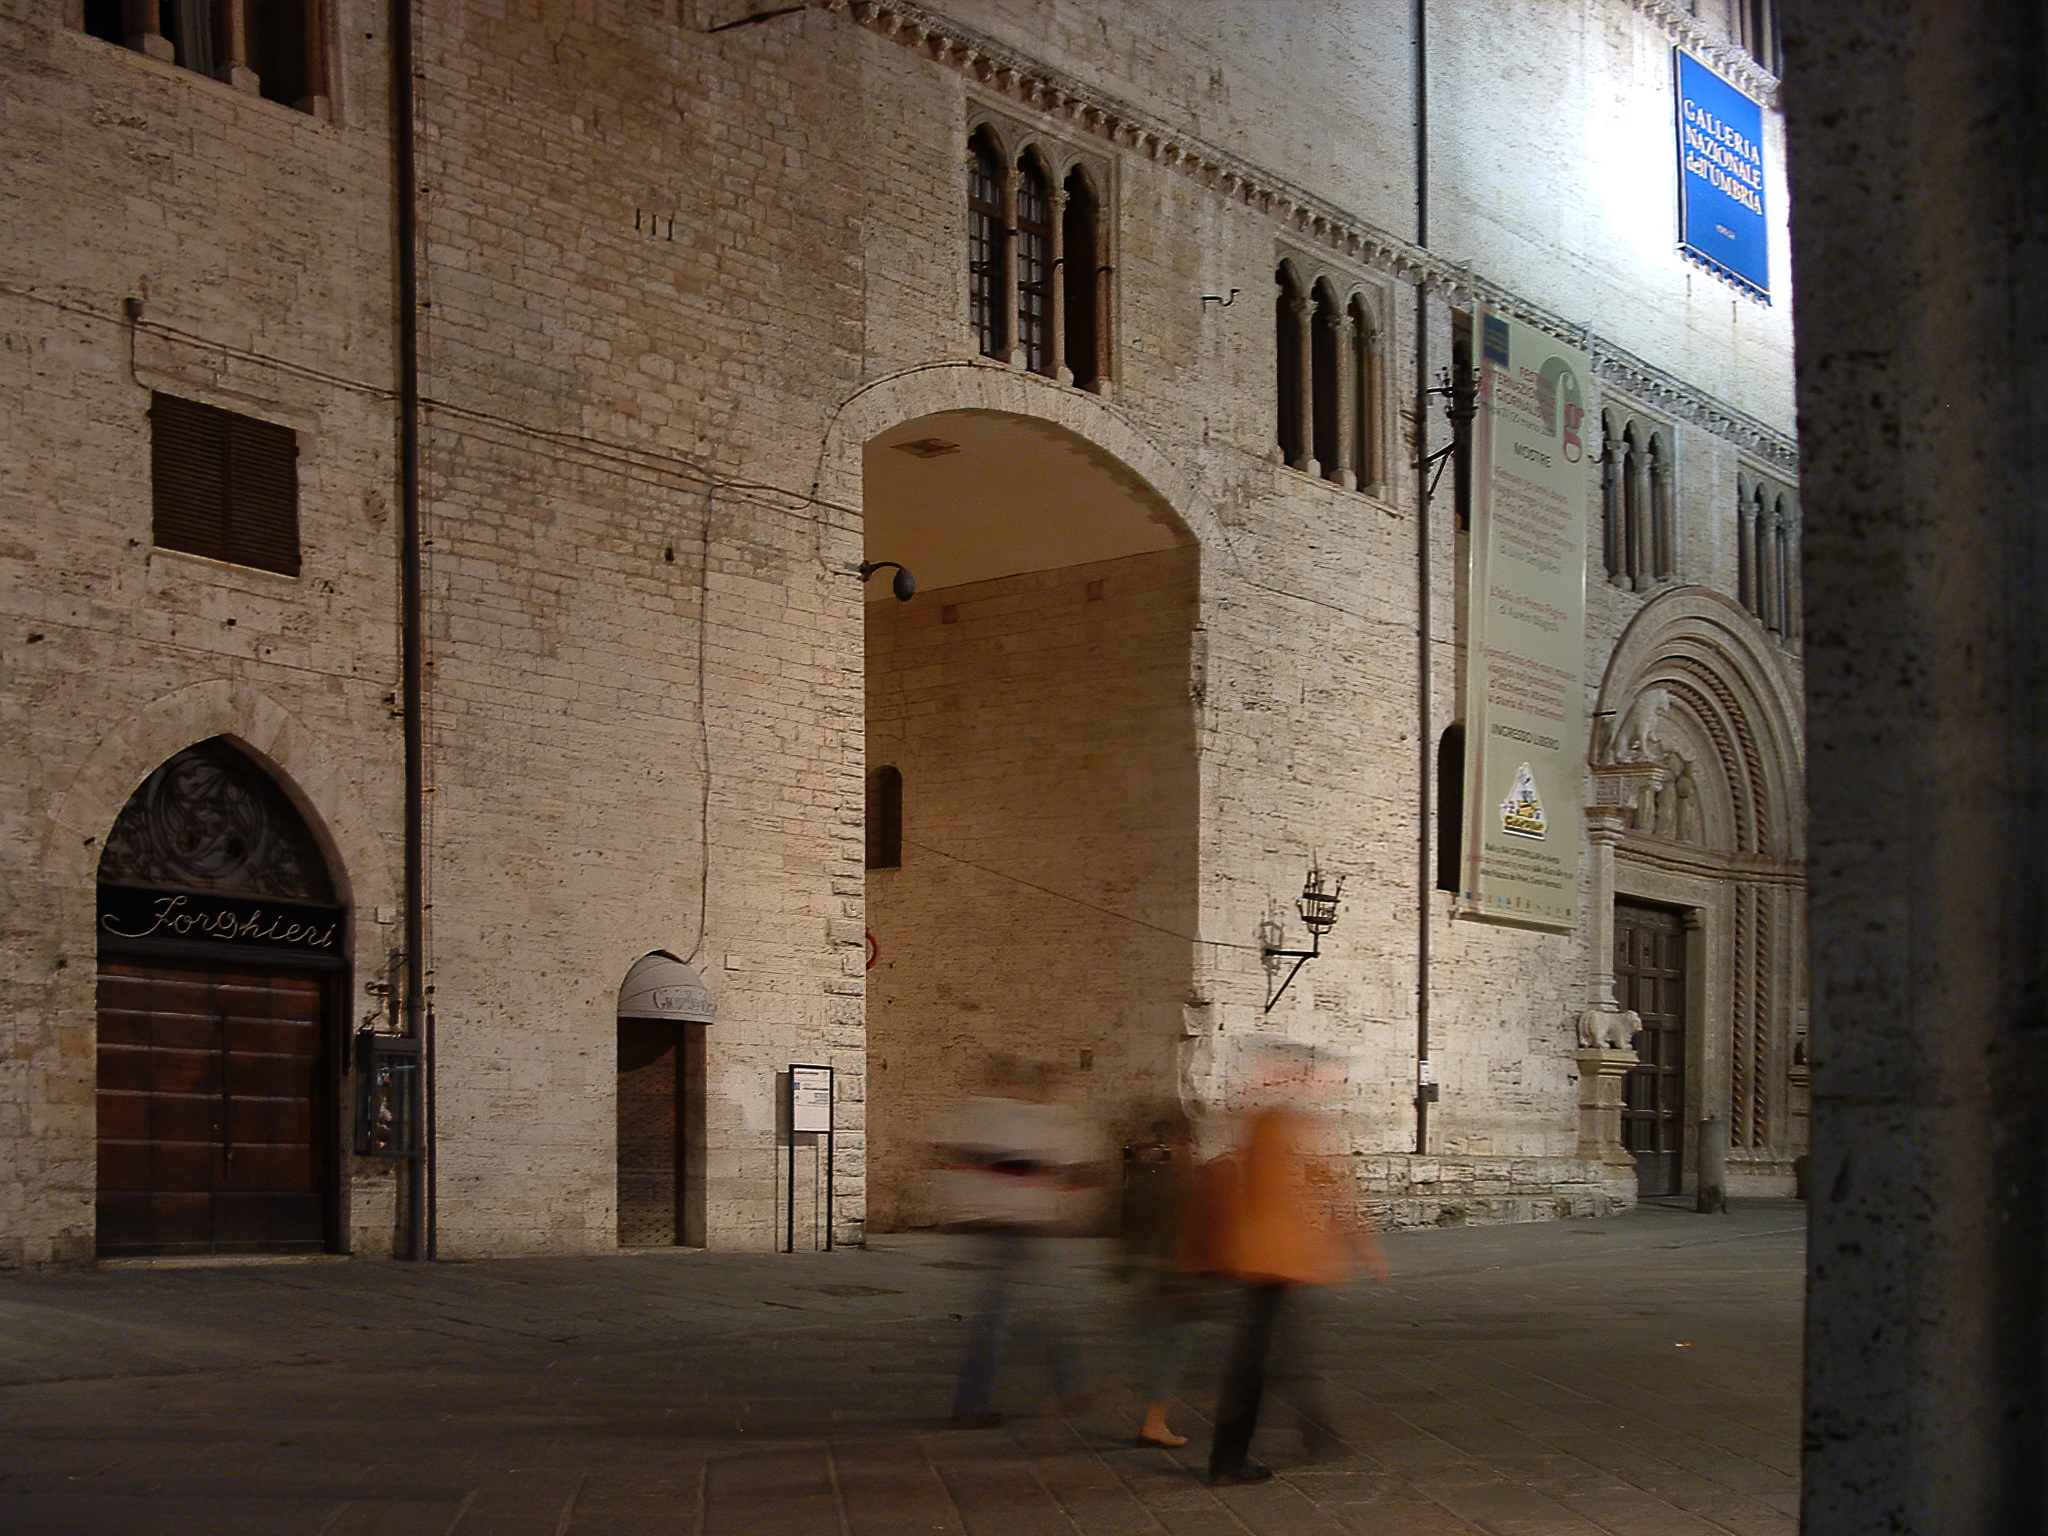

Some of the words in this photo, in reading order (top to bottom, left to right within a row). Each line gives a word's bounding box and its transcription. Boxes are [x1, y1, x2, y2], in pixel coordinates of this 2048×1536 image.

[1683, 99, 1761, 165] GALLERIA
[1685, 123, 1763, 190] NAZIONALE
[101, 895, 336, 948] Forghieri
